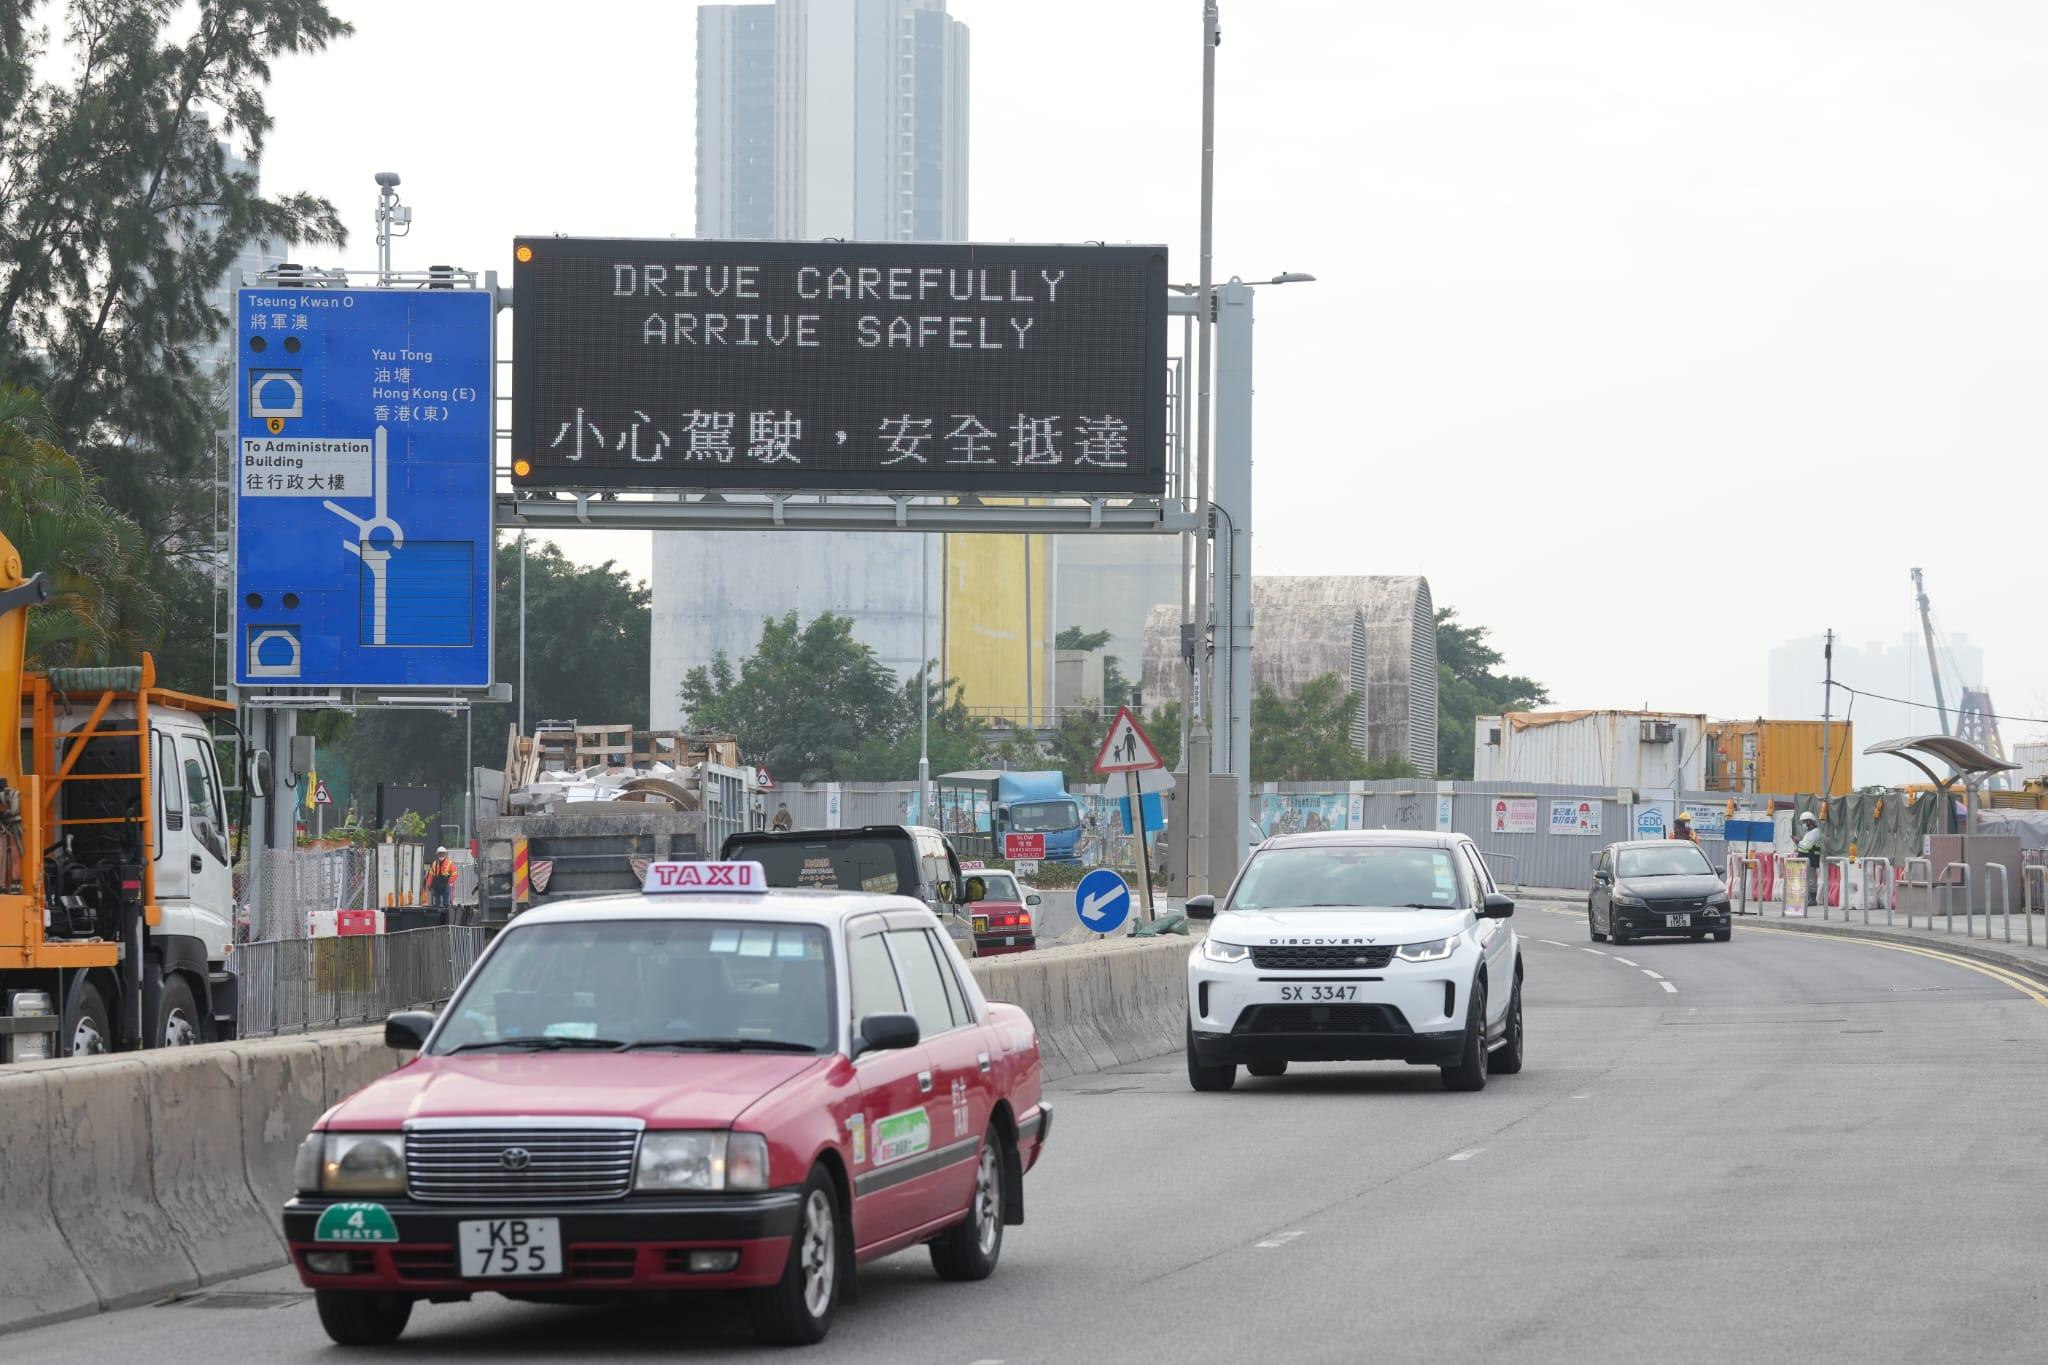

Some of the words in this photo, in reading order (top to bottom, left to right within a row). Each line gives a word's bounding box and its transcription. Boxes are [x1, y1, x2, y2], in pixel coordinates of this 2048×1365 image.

[613, 264, 760, 298] DRIVE
[797, 267, 1065, 302] CAREFULLY
[249, 295, 297, 309] Tseung
[300, 296, 339, 308] Kwan
[343, 296, 354, 308] O
[250, 313, 309, 330] 將軍澳
[643, 312, 820, 347] ARRIVE
[858, 316, 1034, 350] SAFELY
[372, 349, 396, 361] Yau
[400, 349, 433, 363] Tong
[374, 367, 410, 383] 油塘
[373, 387, 409, 401] Hong
[413, 387, 448, 401] Kong
[452, 387, 477, 402] (E)
[271, 419, 280, 431] 6
[244, 440, 261, 453] To
[265, 440, 369, 453] Administration
[245, 455, 304, 469] Building
[246, 473, 345, 491] 往行政大樓
[1637, 816, 1662, 826] CEDD
[655, 865, 751, 886] TAXI
[1280, 986, 1303, 1001] SX
[1311, 986, 1357, 1001] 3347
[347, 1210, 365, 1229] 4
[332, 1229, 383, 1239] SEATS
[488, 1221, 530, 1247] KB
[476, 1246, 546, 1275] 755
